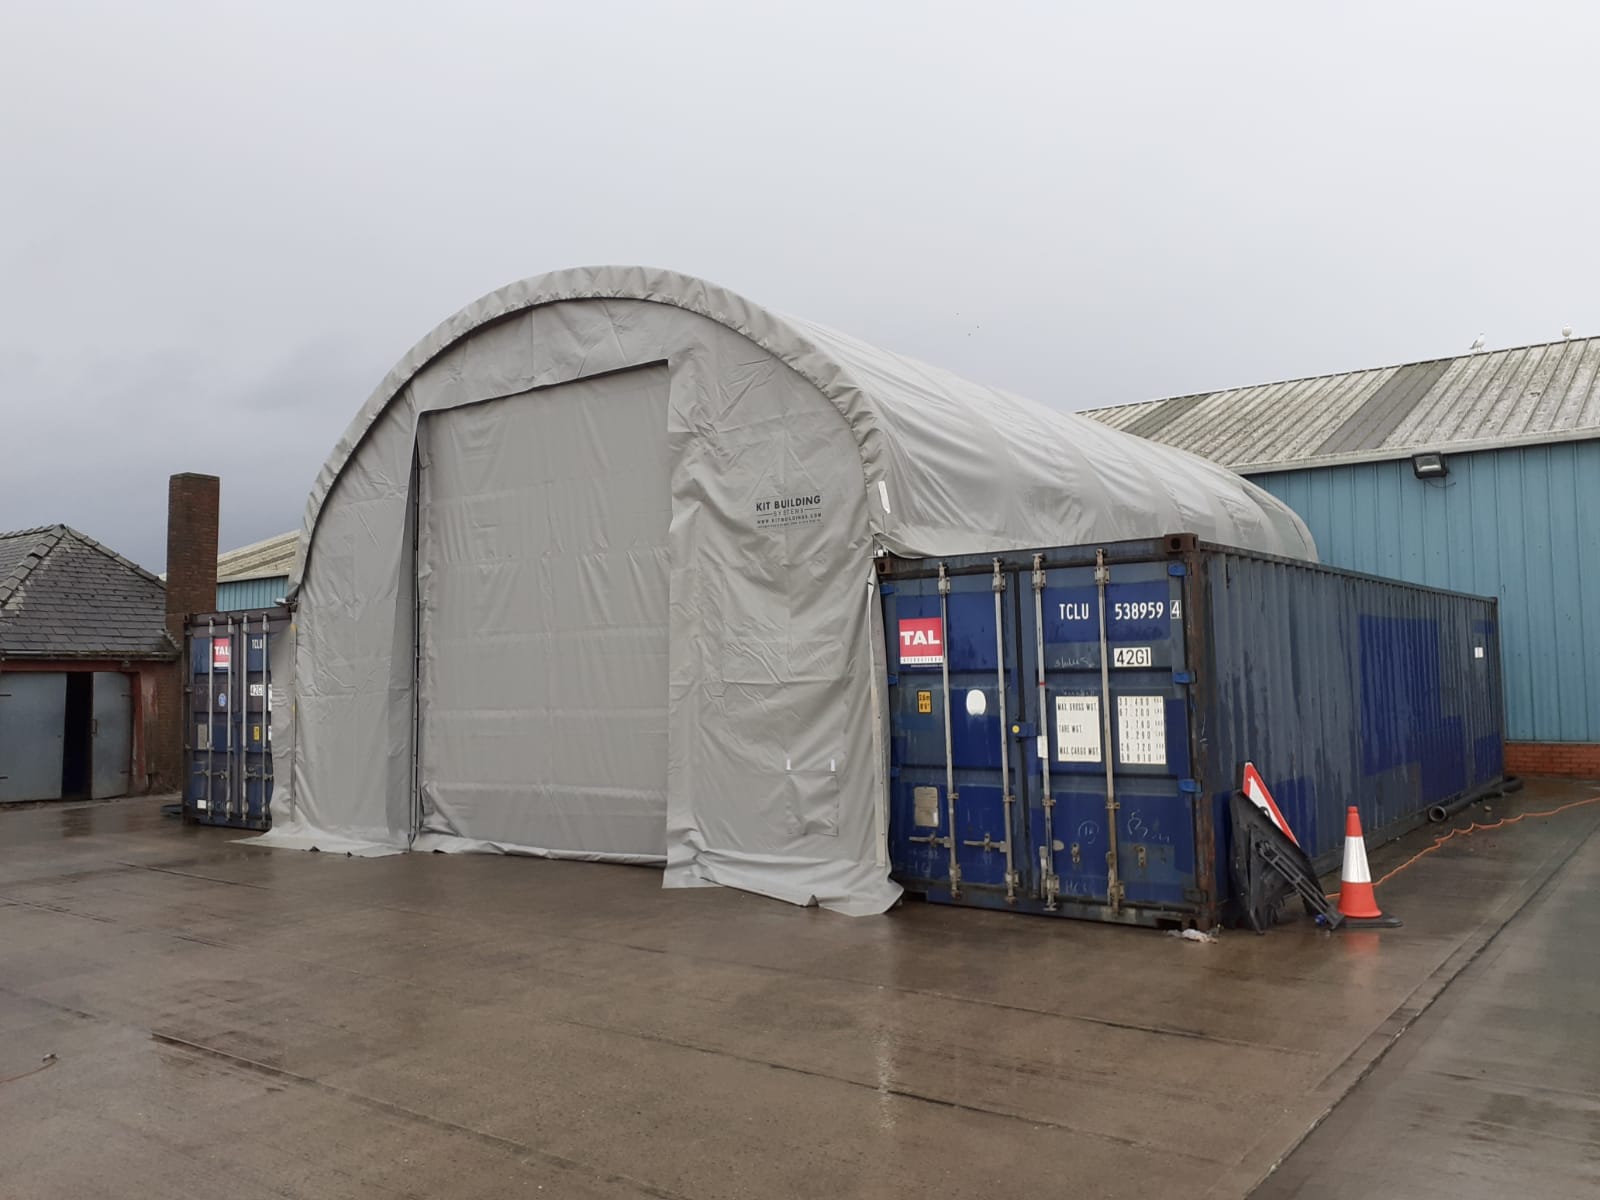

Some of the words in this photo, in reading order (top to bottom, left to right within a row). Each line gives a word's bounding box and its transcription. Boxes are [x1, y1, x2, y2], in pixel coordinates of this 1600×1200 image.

[756, 501, 770, 512] KIT
[774, 495, 821, 509] BUILDING
[1059, 603, 1089, 620] TCLU
[1115, 602, 1164, 620] 538959
[1170, 600, 1180, 618] 4
[900, 630, 940, 646] TAL
